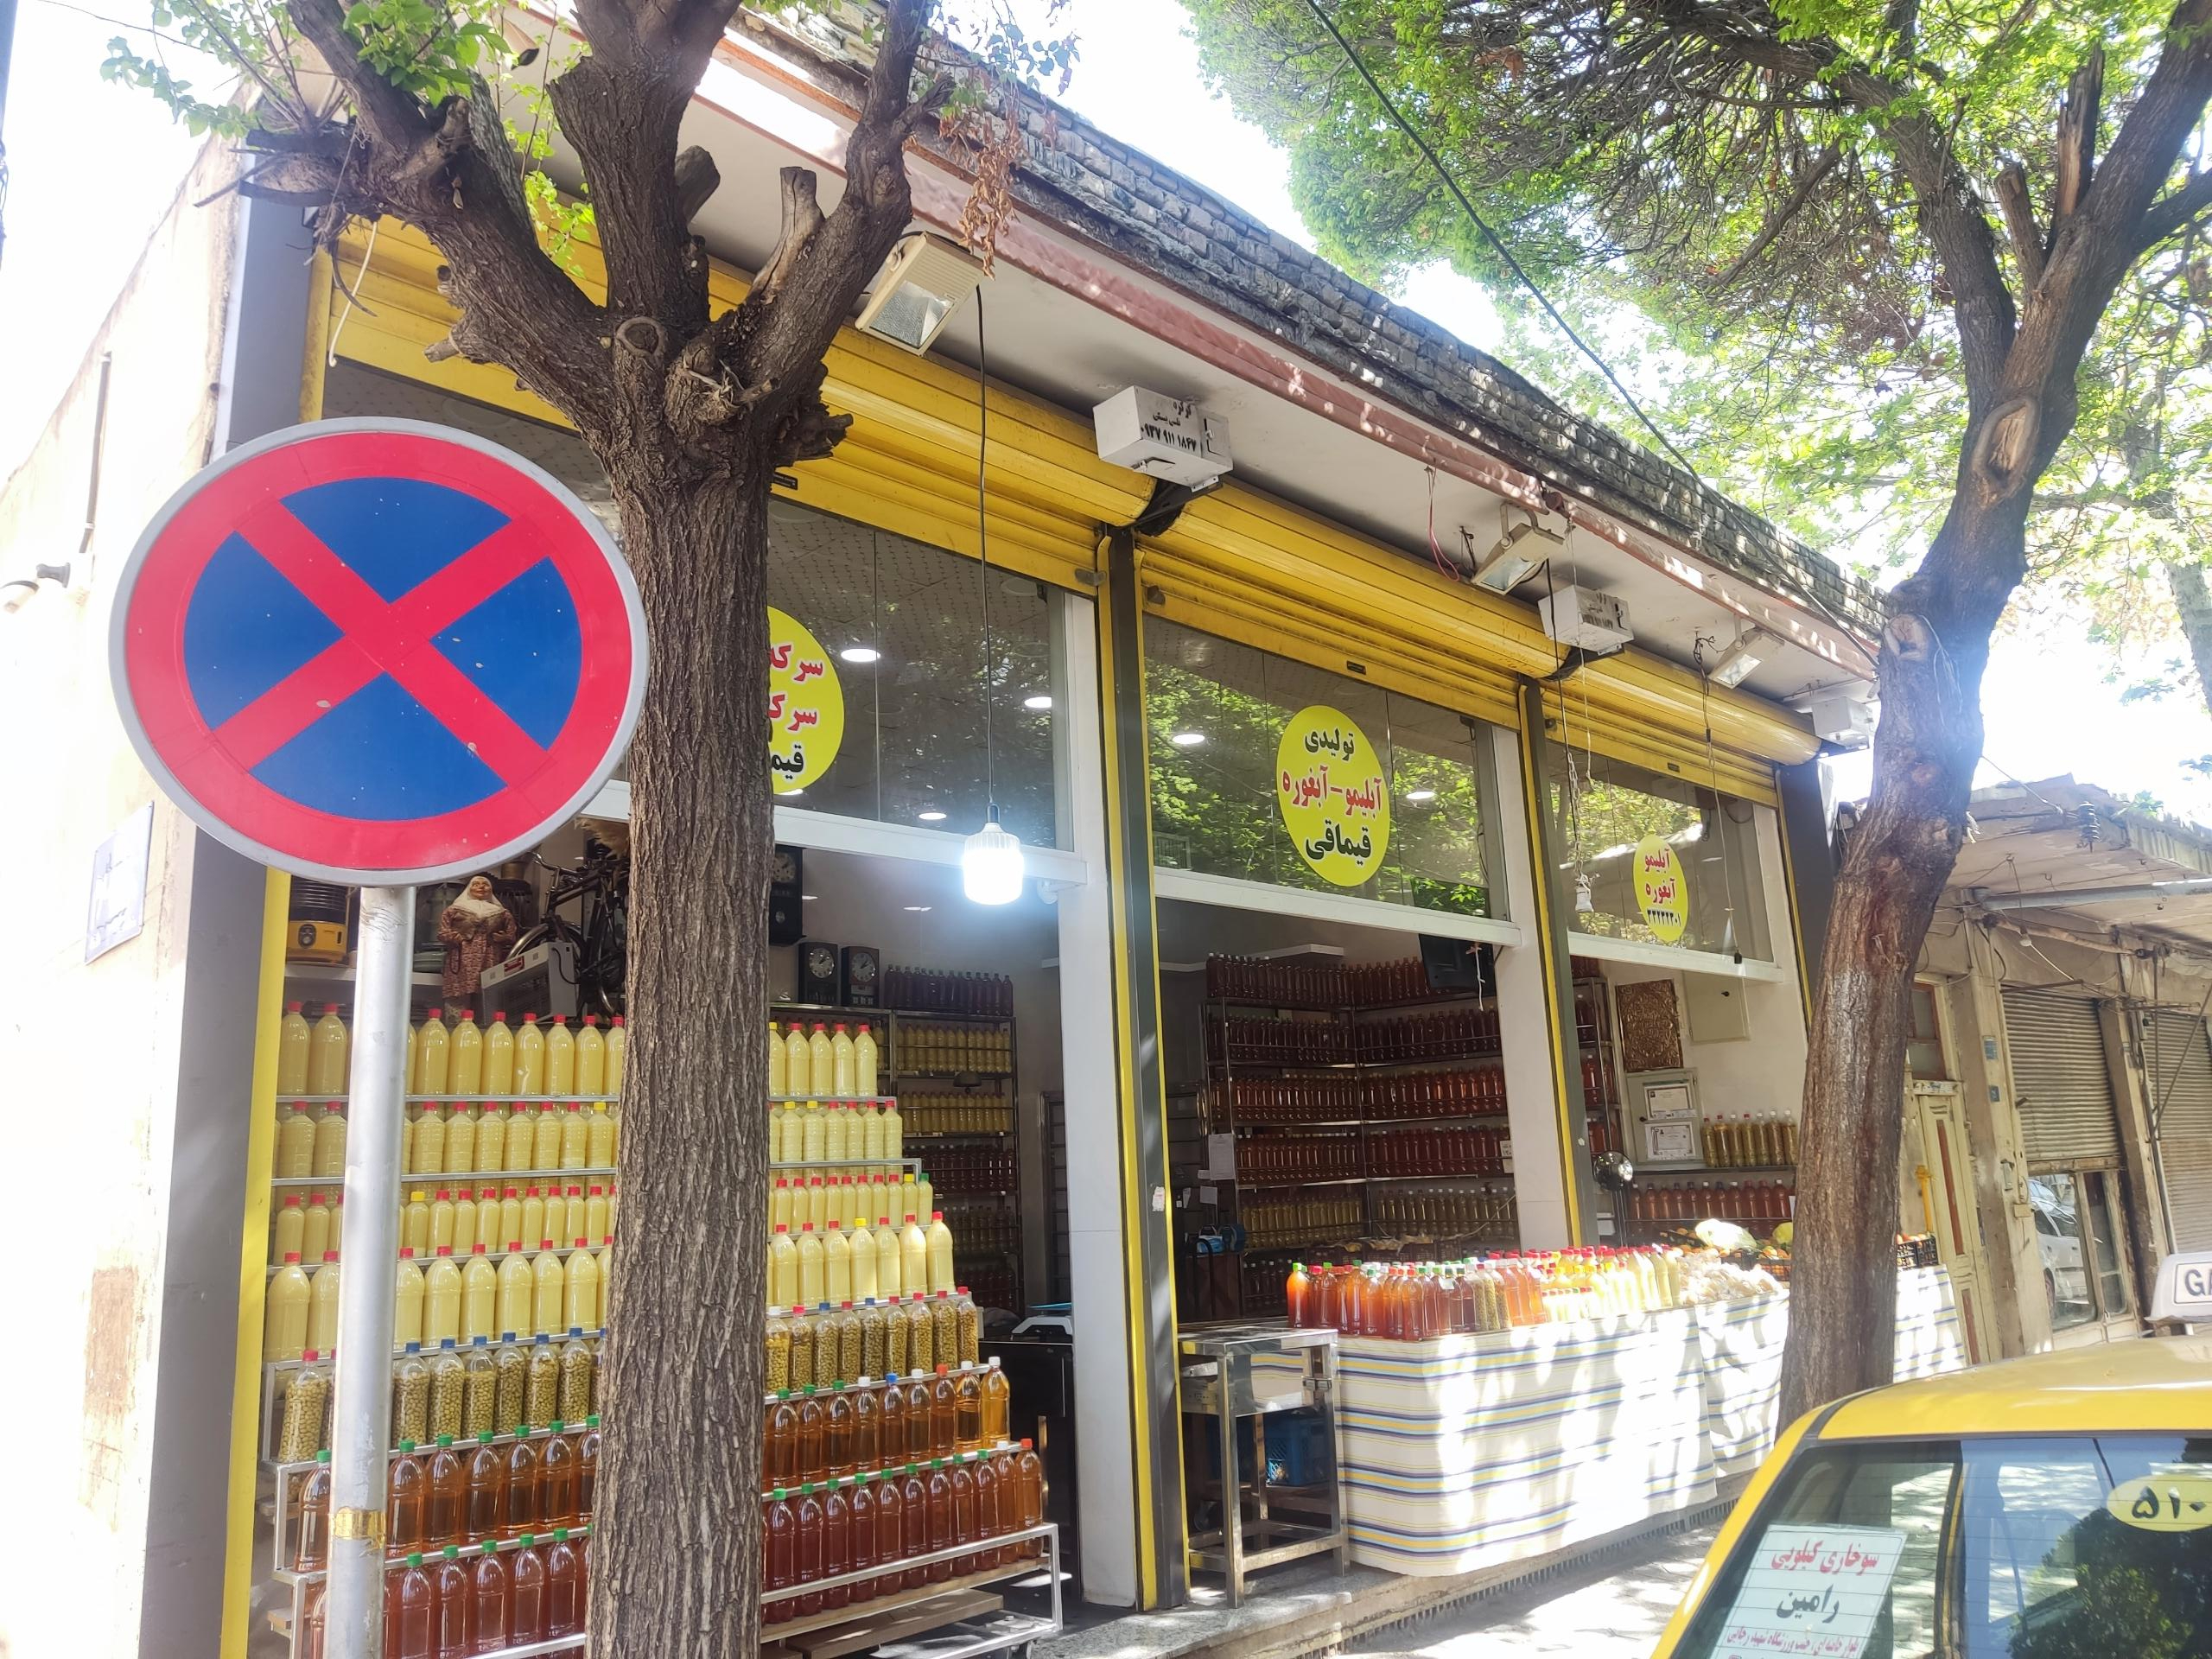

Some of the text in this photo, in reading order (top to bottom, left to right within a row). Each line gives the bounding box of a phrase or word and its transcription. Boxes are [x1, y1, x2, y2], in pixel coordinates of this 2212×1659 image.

[1141, 423, 1197, 452] ۰۹۳۷ ۹۱۱ ۱۸۴۷
[771, 645, 823, 682] سرک
[767, 694, 817, 731] سرک
[1305, 728, 1355, 761] تولیدی
[1306, 819, 1372, 865] قیماقی
[1644, 849, 1670, 874] آبلیمو
[1645, 878, 1675, 904] آبغوره
[2131, 1485, 2208, 1520] ۵۱۰
[1819, 1542, 1879, 1576] سوخاری
[1776, 1583, 1840, 1624] رامین
